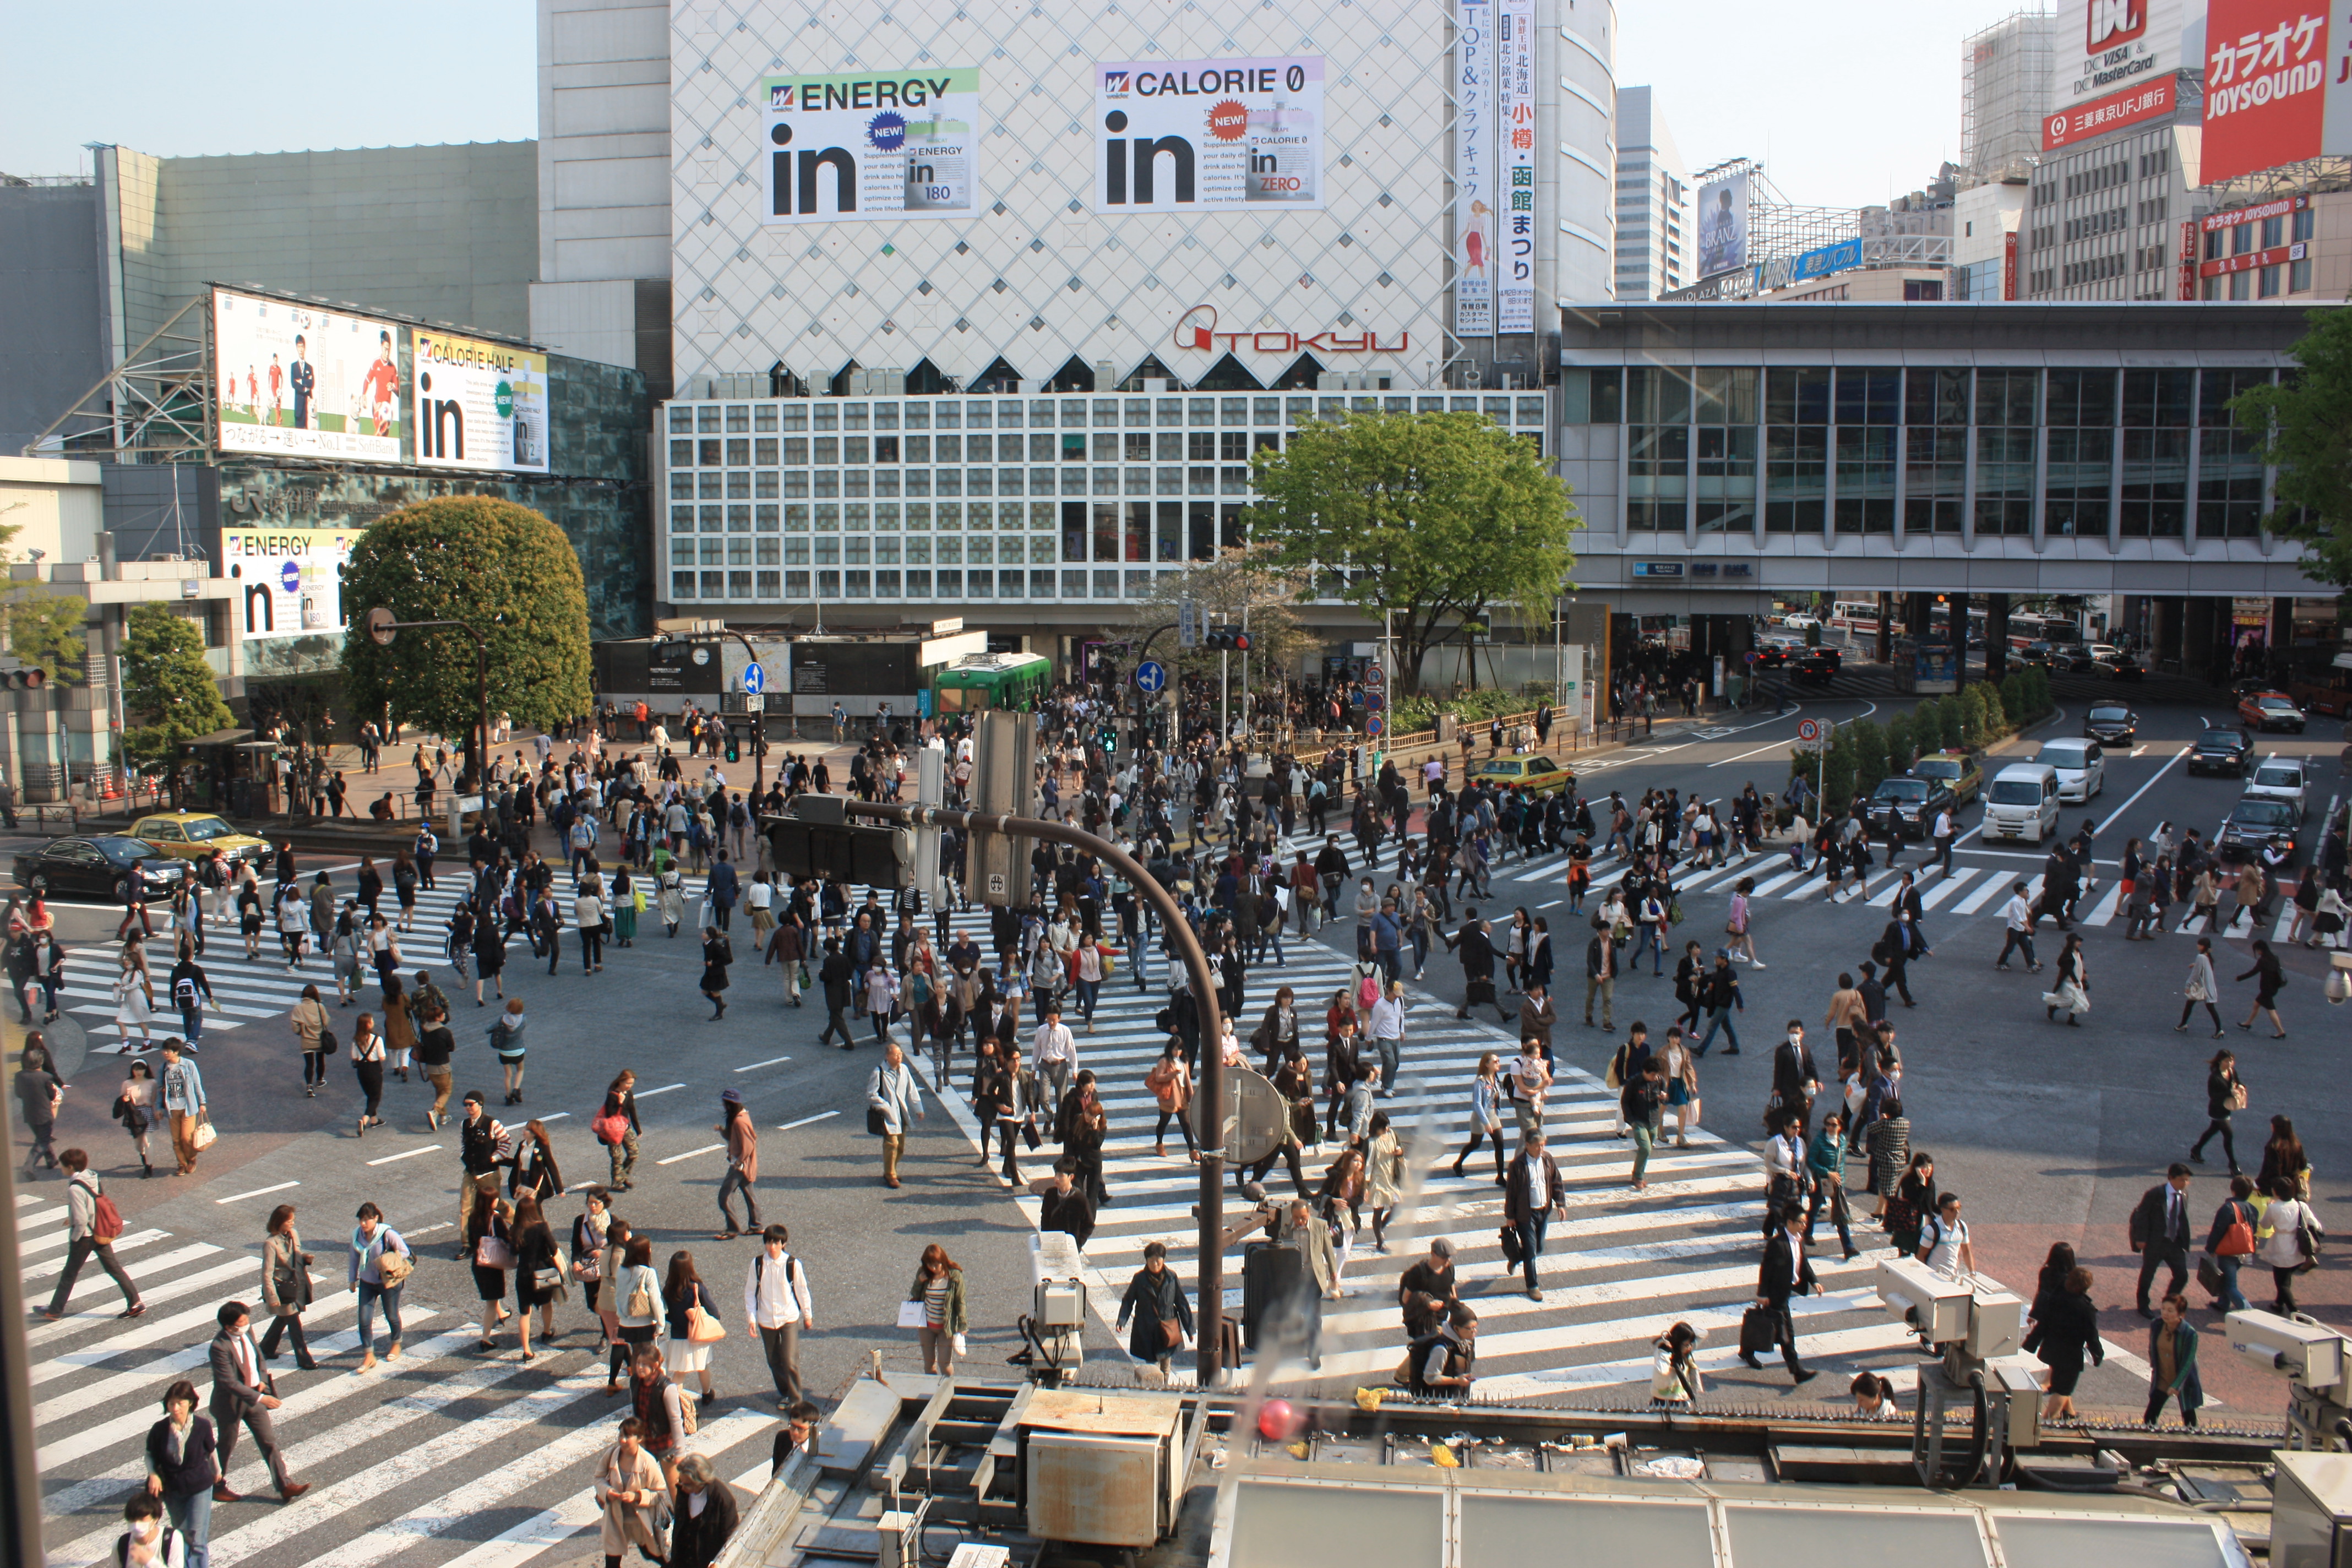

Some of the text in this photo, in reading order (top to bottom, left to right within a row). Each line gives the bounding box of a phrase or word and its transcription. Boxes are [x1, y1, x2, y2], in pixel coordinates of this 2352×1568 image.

[2084, 42, 2144, 75] DC VISA &
[2209, 15, 2323, 88] カラオケ
[1135, 68, 1277, 97] CALORIE
[1516, 55, 1529, 95] 北海道
[2073, 54, 2154, 95] DC MasterCard
[802, 78, 951, 111] ENERGY
[2207, 60, 2322, 121] JOYSOUND
[1215, 115, 1245, 127] NEW!
[2075, 88, 2165, 132] 三菱東京UFJ銀行
[875, 126, 903, 138] NEW!
[919, 146, 963, 156] ENERGY
[1105, 110, 1195, 204] in
[1251, 148, 1277, 173] in
[771, 123, 857, 216] in
[910, 159, 934, 183] in
[925, 186, 950, 200] 180
[1260, 177, 1300, 191] ZERO
[2207, 199, 2305, 230] カラオケ JOYSOUND 9F
[1706, 225, 1736, 249] BRANZ
[2292, 247, 2301, 257] 8F
[1214, 331, 1408, 352] TOKYU
[434, 344, 484, 370] CALORIE
[487, 353, 514, 375] HALF
[497, 396, 512, 405] NEW!
[421, 372, 464, 460] in
[515, 415, 527, 439] in
[225, 426, 396, 455] つながる 速い No.1 SoftBank
[523, 442, 535, 457] 1/2
[245, 536, 312, 556] ENERGY
[283, 573, 299, 582] NEW!
[302, 593, 313, 610] in
[309, 613, 320, 622] 180
[1185, 602, 1194, 643] 渋谷駅前
[1594, 613, 1604, 665] Smoking
